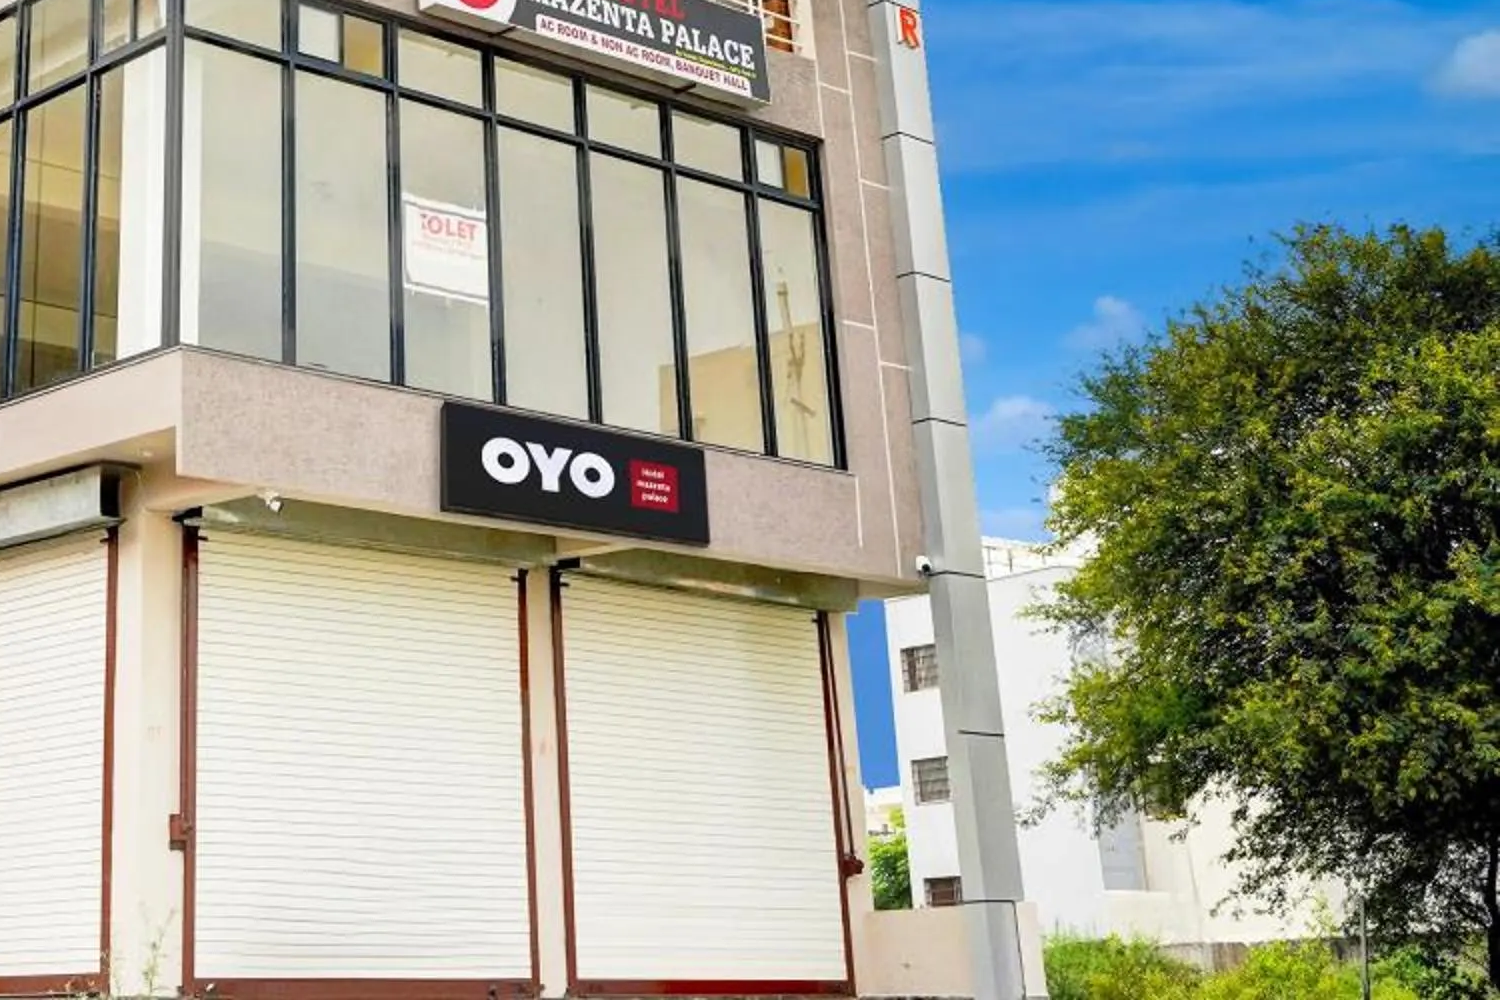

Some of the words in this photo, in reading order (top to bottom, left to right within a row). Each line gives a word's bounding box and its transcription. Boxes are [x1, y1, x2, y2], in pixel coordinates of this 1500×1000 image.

[540, 17, 555, 32] AC
[557, 23, 589, 43] ROOM
[591, 34, 598, 46] &
[601, 36, 623, 53] NON
[625, 46, 640, 58] AC
[675, 59, 721, 81] BANQUET
[723, 74, 749, 92] HALL
[659, 17, 756, 70] PALACE
[481, 436, 616, 499] OYO
